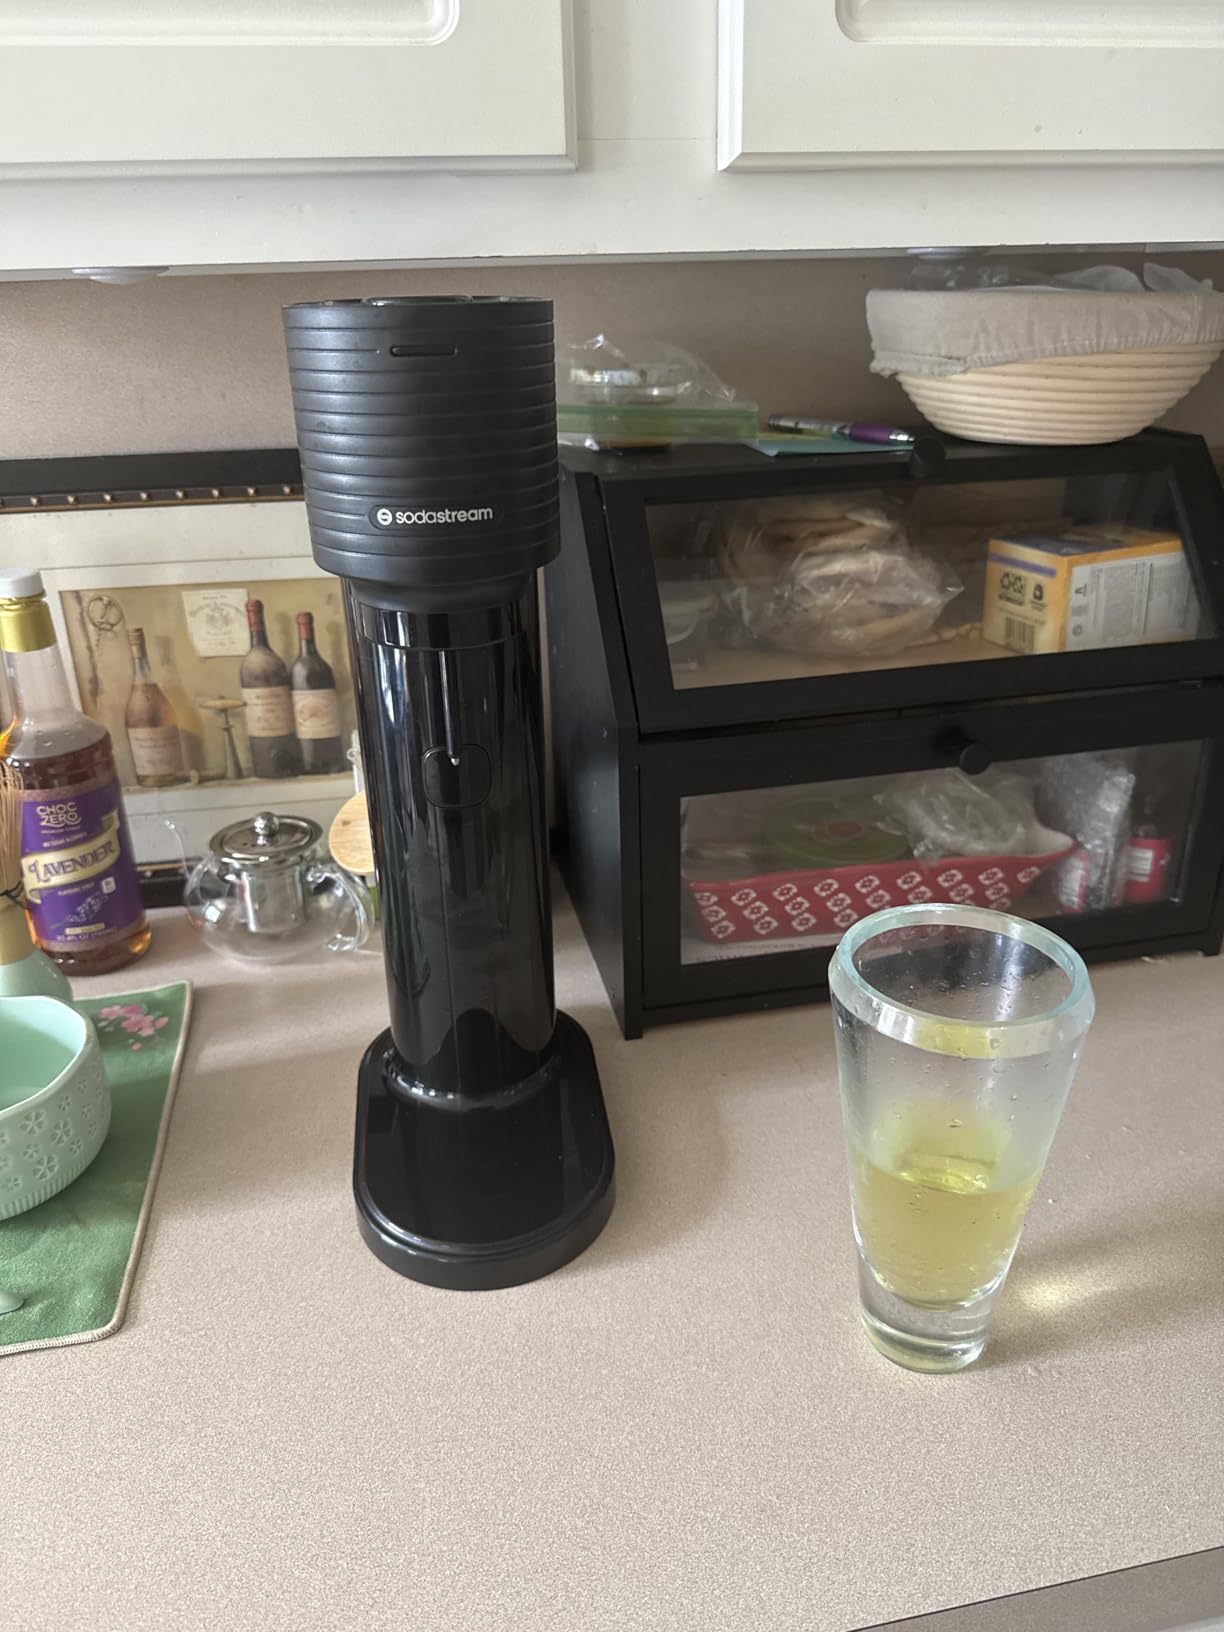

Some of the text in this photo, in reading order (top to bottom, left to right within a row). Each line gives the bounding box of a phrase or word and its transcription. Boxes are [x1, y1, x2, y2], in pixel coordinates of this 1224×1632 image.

[395, 508, 493, 524] sodastream
[36, 802, 77, 815] CHOC
[40, 812, 81, 827] ZERO
[28, 840, 114, 882] LAVENDER
